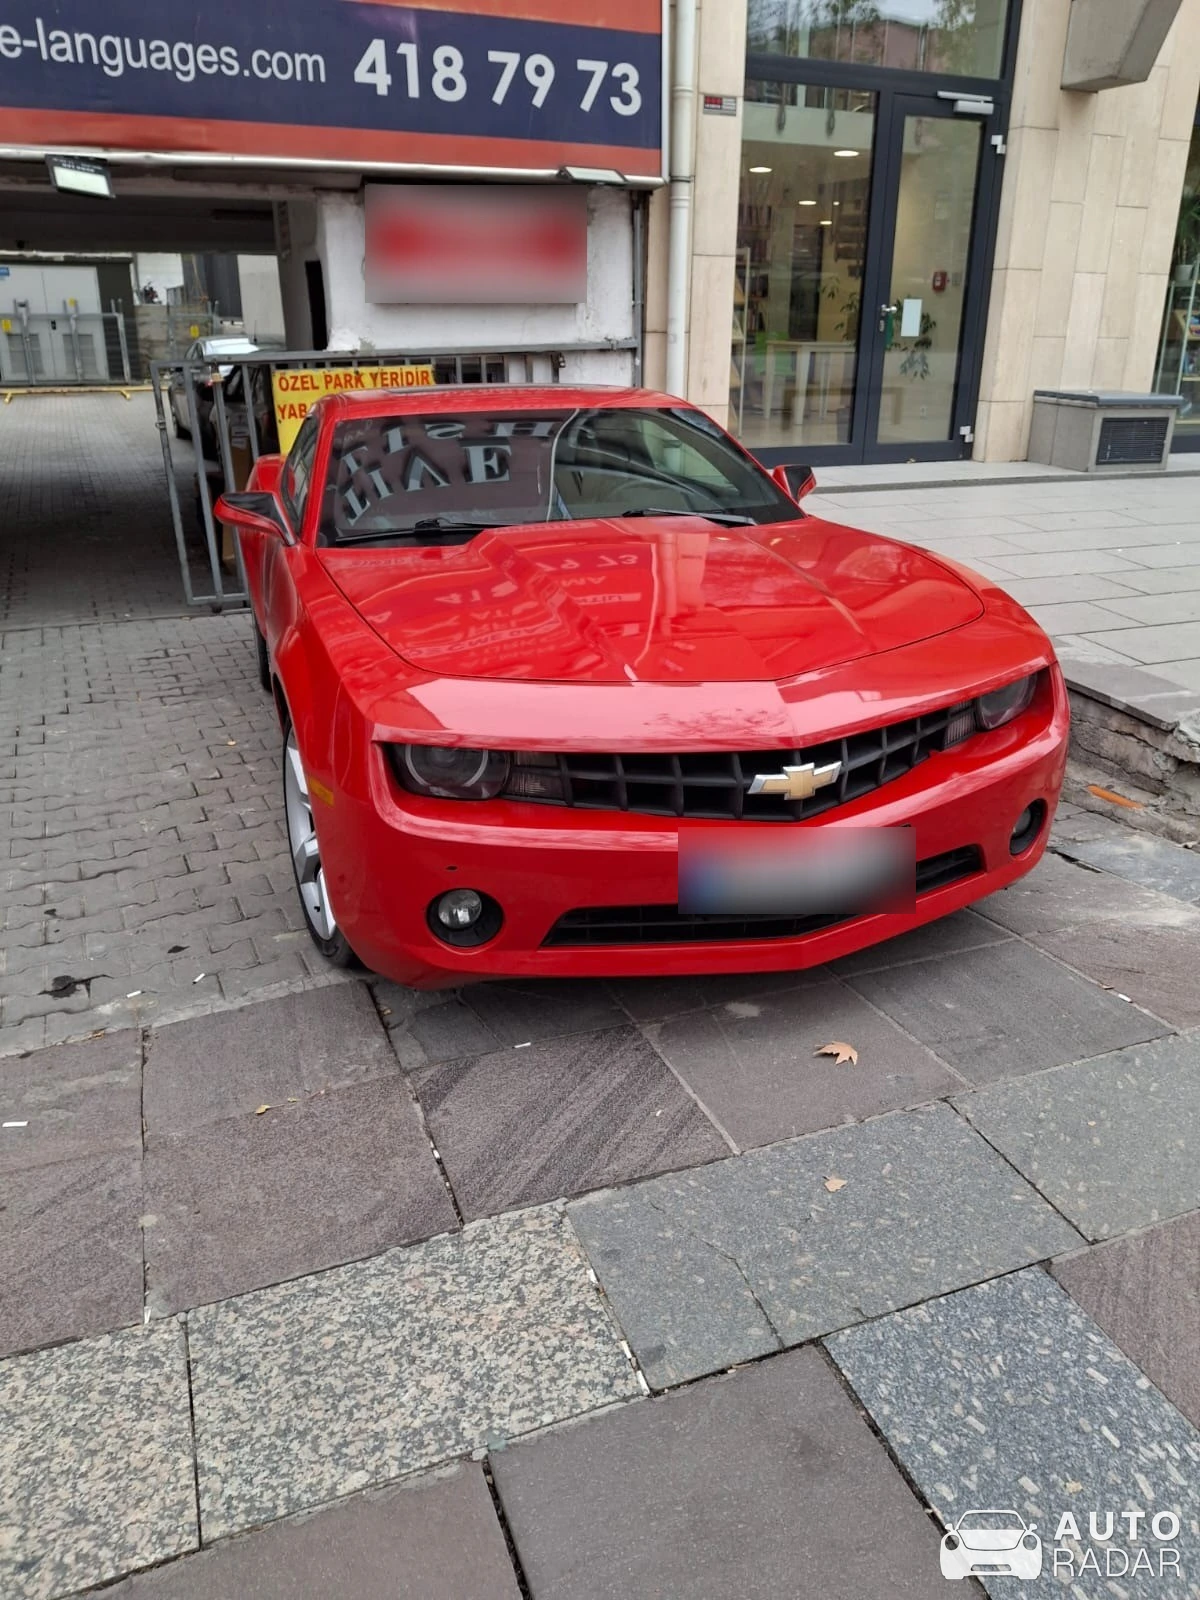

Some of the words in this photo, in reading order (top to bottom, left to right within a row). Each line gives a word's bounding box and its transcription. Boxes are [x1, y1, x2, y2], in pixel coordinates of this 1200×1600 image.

[0, 17, 326, 83] e-languages.com
[353, 38, 467, 102] 418
[487, 50, 555, 109] 79
[576, 59, 642, 116] 73
[278, 371, 319, 392] ÖZEL
[324, 372, 365, 391] PARK
[369, 367, 430, 388] YERİDİR
